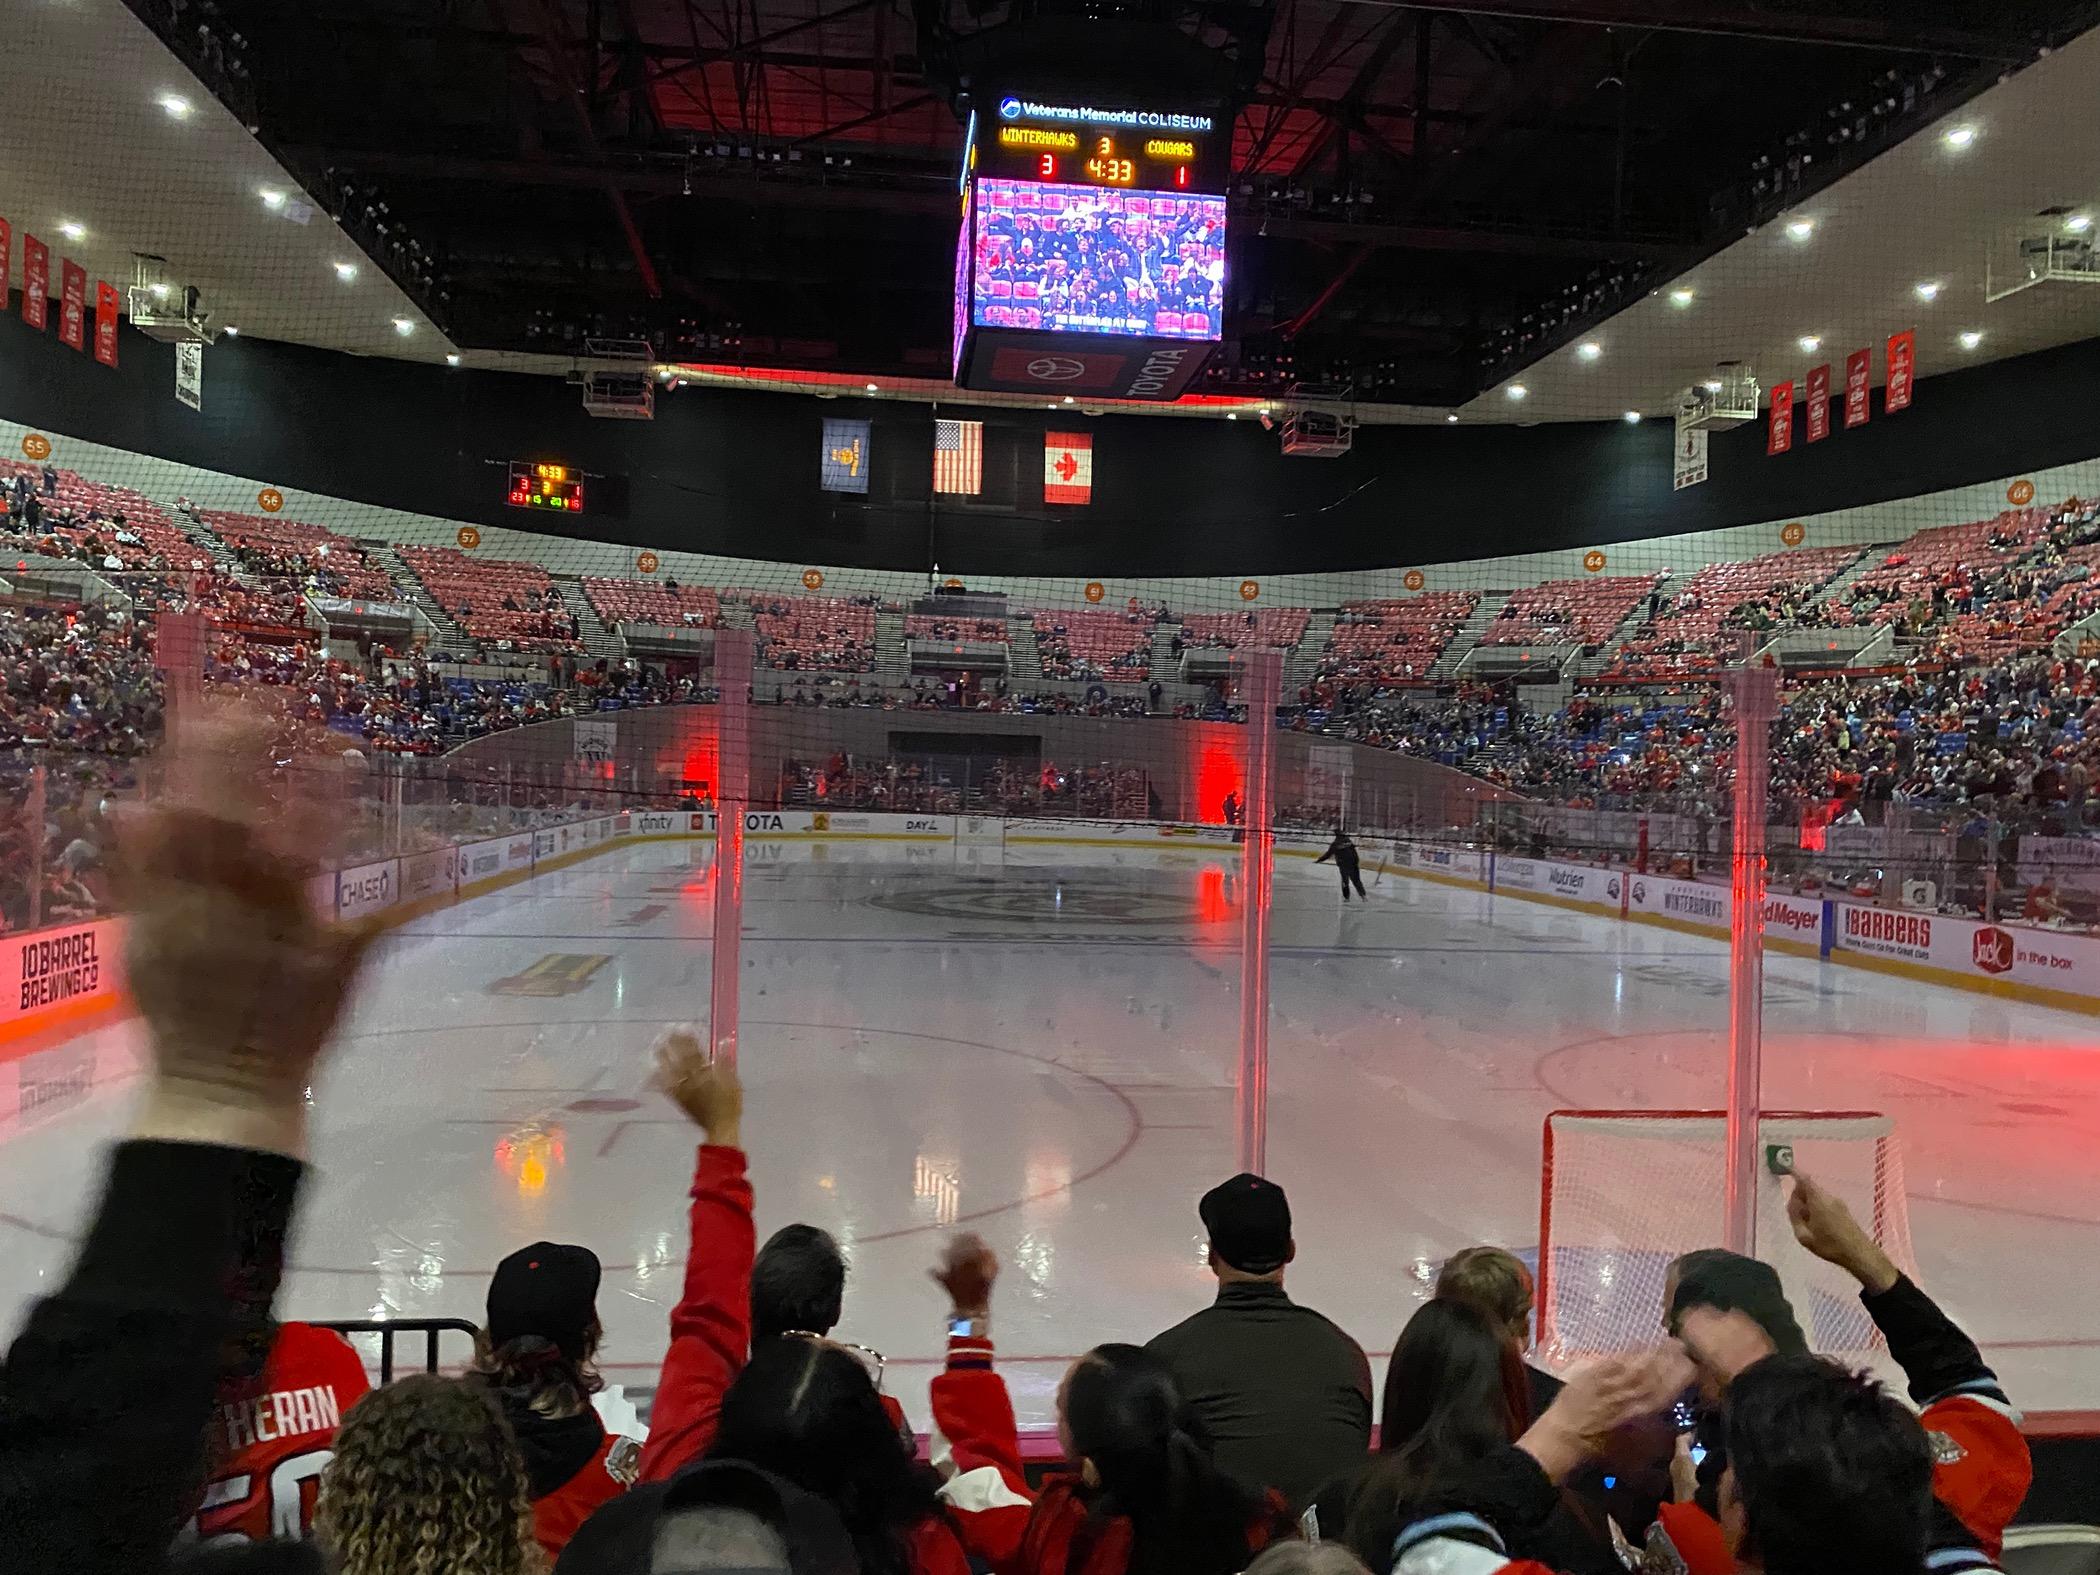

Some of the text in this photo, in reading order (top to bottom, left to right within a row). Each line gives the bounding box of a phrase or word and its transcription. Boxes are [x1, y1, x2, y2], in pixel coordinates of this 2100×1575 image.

[1023, 102, 1211, 130] Veterans Memorial COLISEUM
[1002, 128, 1076, 147] WINTERHAWKS
[1101, 137, 1110, 154] 3
[1148, 141, 1193, 156] COUGARS
[1042, 154, 1185, 184] 3 4:33 1
[1126, 349, 1188, 396] TOYOTA
[27, 440, 45, 453] 55
[539, 465, 562, 480] 4:33
[521, 479, 528, 490] 3
[263, 496, 278, 506] 56
[461, 532, 476, 543] 57
[641, 558, 655, 568] 58
[1587, 557, 1602, 566] 64
[638, 813, 673, 833] xfinity
[1549, 867, 1584, 889] Nutrien
[341, 876, 380, 907] CHASE
[1664, 893, 1723, 918] WINTERHAWKS
[1976, 931, 2073, 970] Jack in the box
